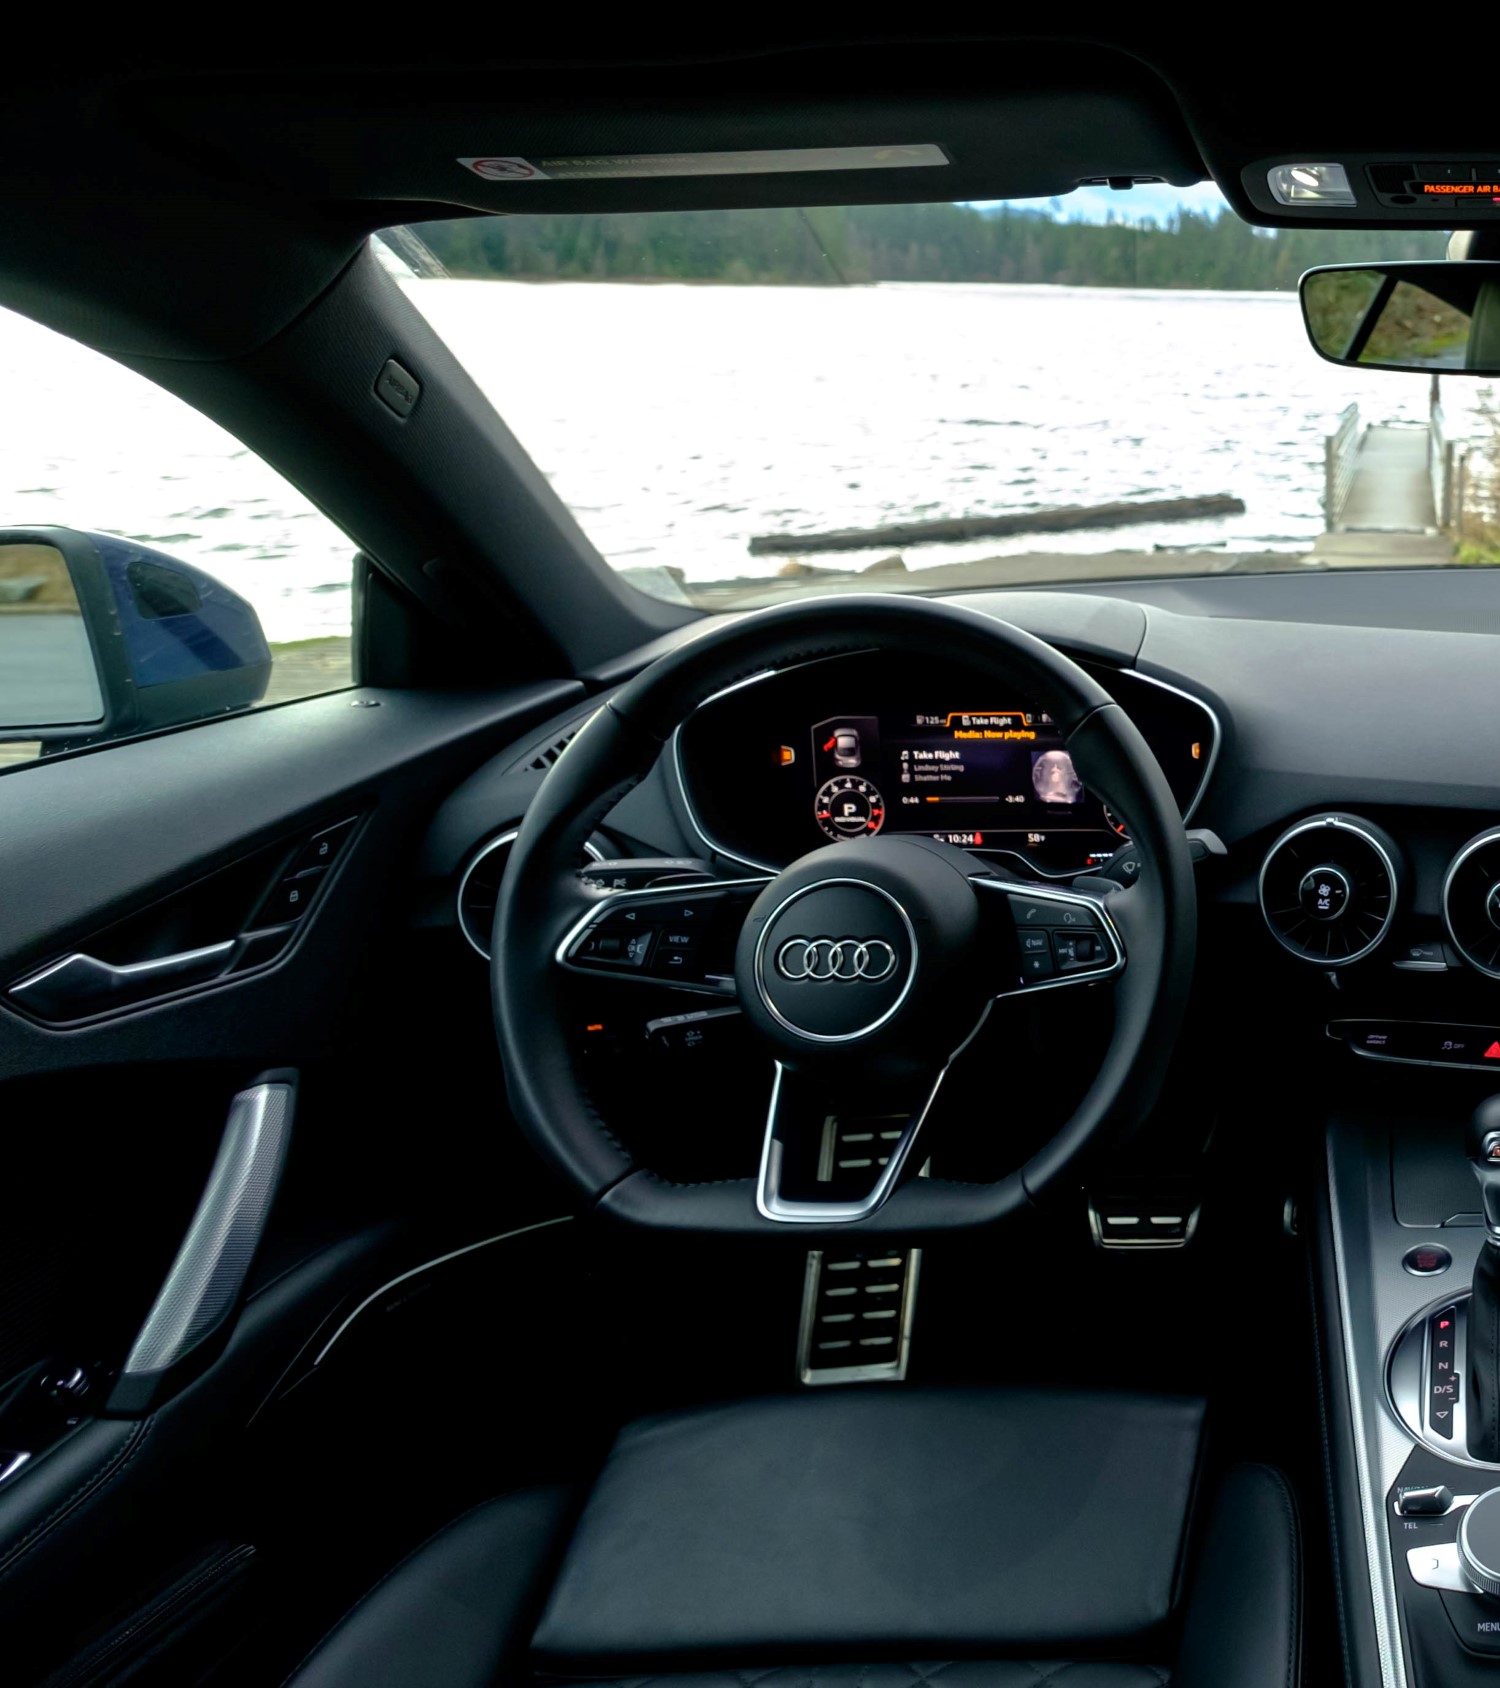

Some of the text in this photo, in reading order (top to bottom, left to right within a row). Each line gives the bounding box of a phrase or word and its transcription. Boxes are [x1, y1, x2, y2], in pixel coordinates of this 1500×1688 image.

[1424, 184, 1474, 194] PASSENGER
[1476, 184, 1492, 194] AIR
[972, 717, 1012, 726] Take Flight
[954, 730, 1036, 740] Media: Now playing
[913, 751, 960, 761] Take Flight
[843, 804, 857, 816] P
[948, 834, 974, 844] 10:24
[1317, 898, 1330, 906] A/C
[668, 935, 690, 944] VIEW
[1440, 1320, 1449, 1328] P
[1434, 1385, 1454, 1394] D/S
